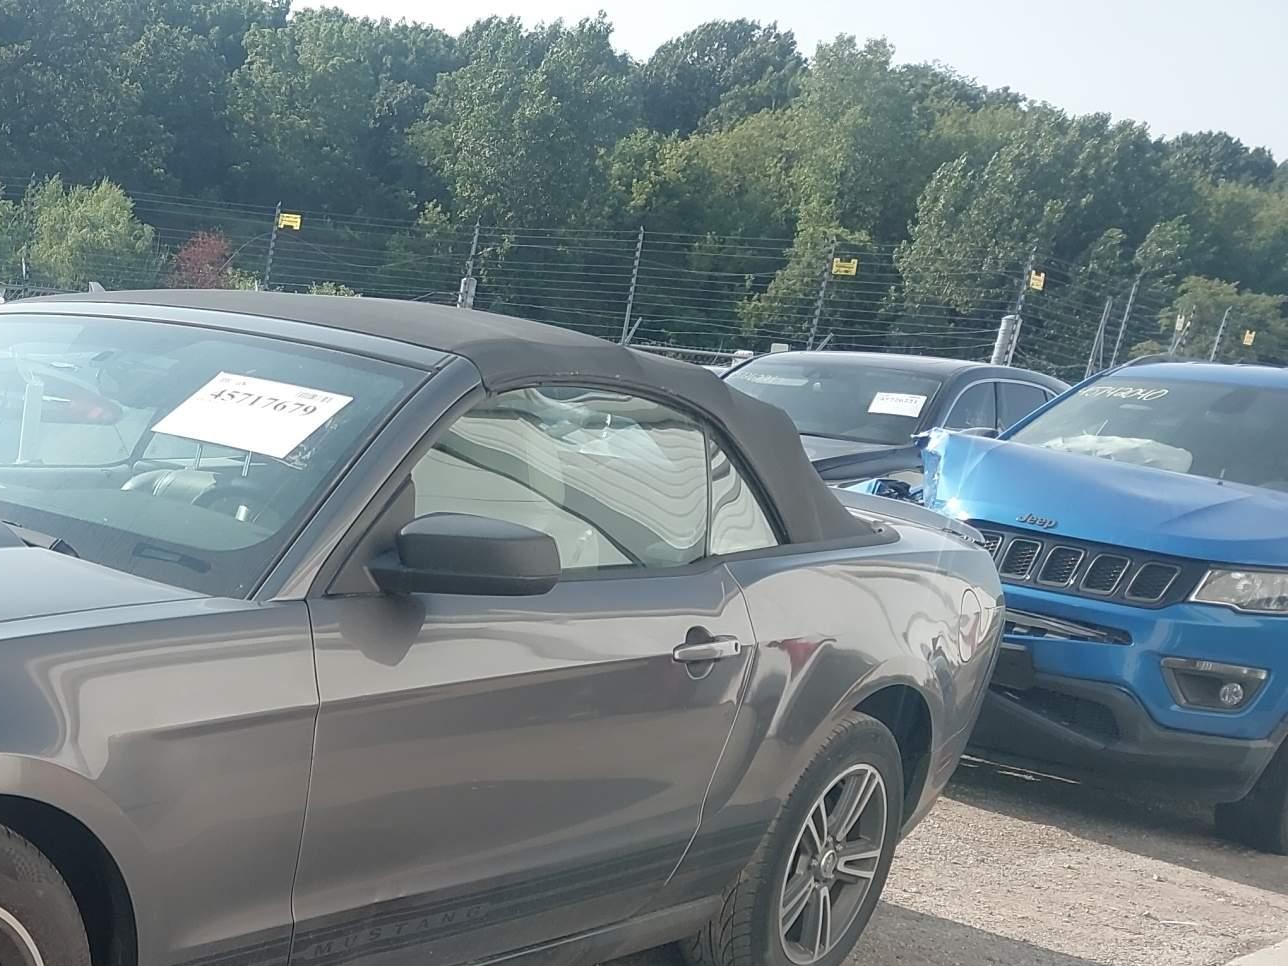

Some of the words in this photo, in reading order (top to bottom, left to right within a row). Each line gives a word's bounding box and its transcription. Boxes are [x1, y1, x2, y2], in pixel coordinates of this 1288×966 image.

[210, 388, 318, 417] 45717679
[1015, 512, 1059, 530] Jeep
[314, 905, 489, 957] MUSTANG
